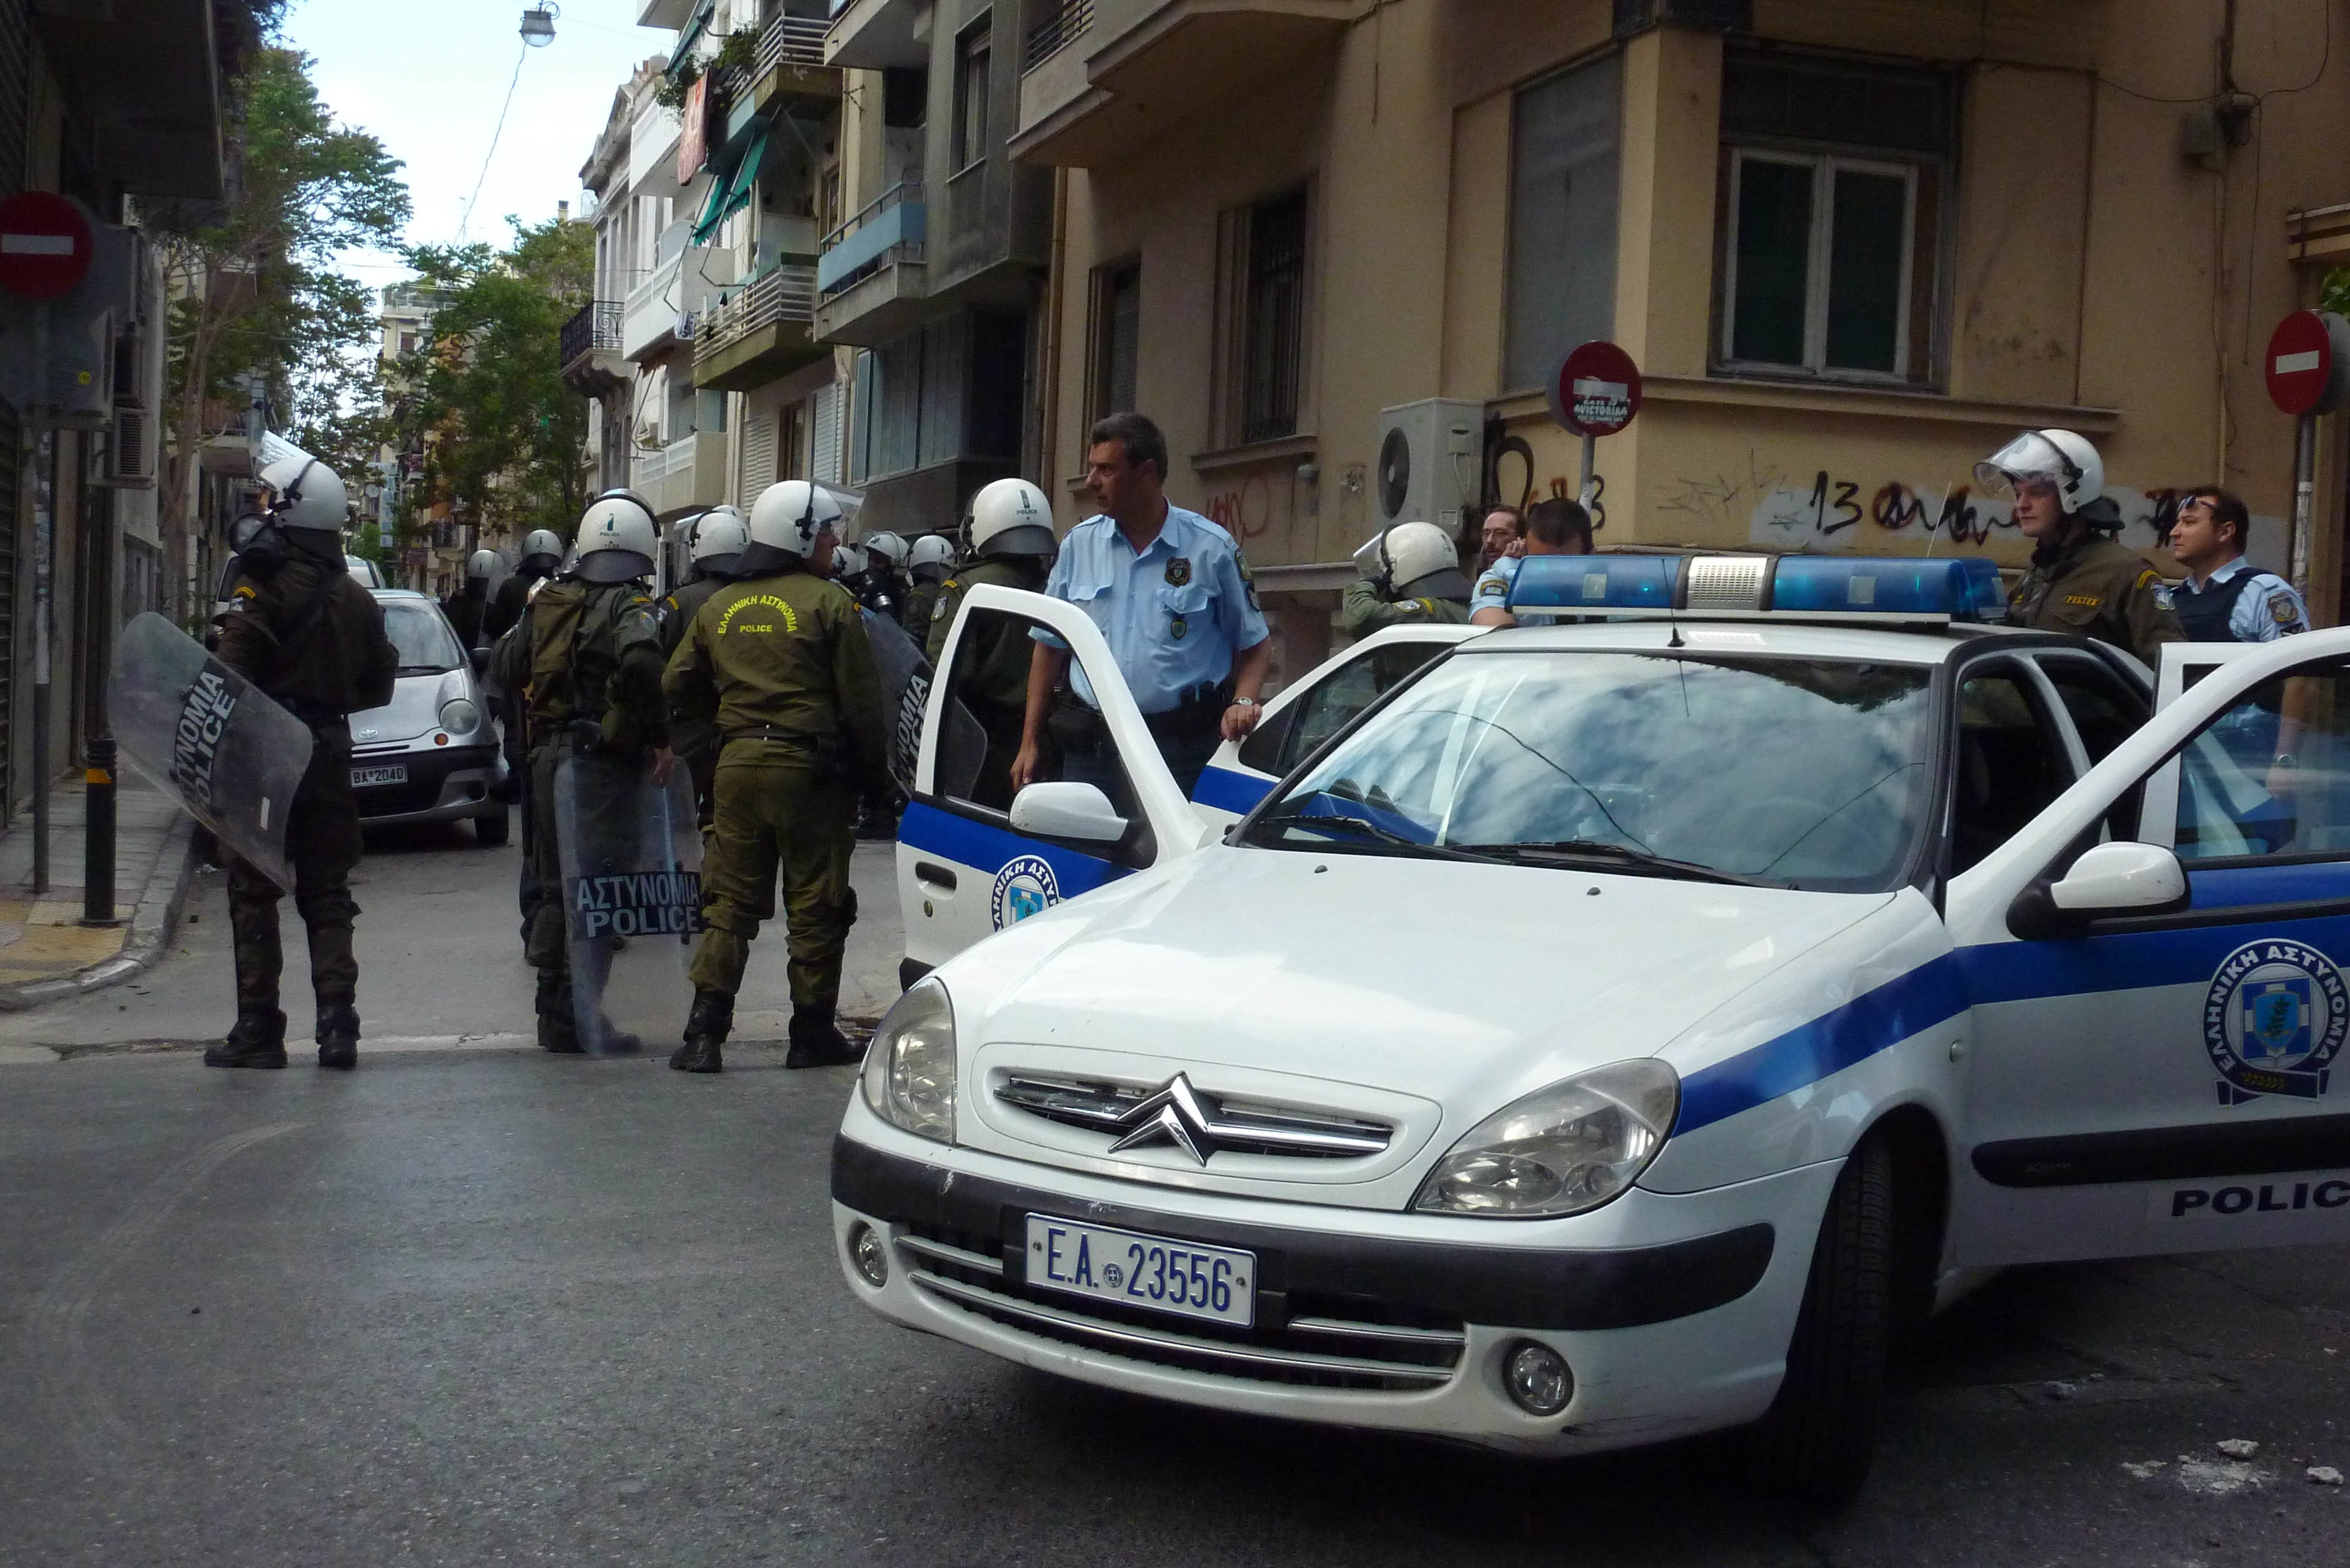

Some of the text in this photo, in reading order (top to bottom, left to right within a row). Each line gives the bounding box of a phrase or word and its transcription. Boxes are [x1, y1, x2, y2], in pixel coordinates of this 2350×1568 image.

[718, 595, 797, 634] ΕΛΛΗΝΙΚΗ ΑΣΤΥΝΟΜΙΑ
[739, 625, 773, 633] POLICE
[897, 674, 929, 762] ΝΟΜΙΑ
[196, 689, 236, 805] OLICE
[353, 768, 404, 784] BA 2040
[576, 874, 700, 912] ΑΣΤΥΝΟΜΙΑ
[993, 861, 1025, 926] ΛΗΝΙΚΗ
[586, 906, 699, 938] POLICE
[2207, 945, 2346, 1072] ΕΛΛΗΝΙΚΗ ΑΣΤΥΝΟΜΙΑ
[2171, 1180, 2350, 1217] POLIC
[1126, 1241, 1232, 1312] 23556
